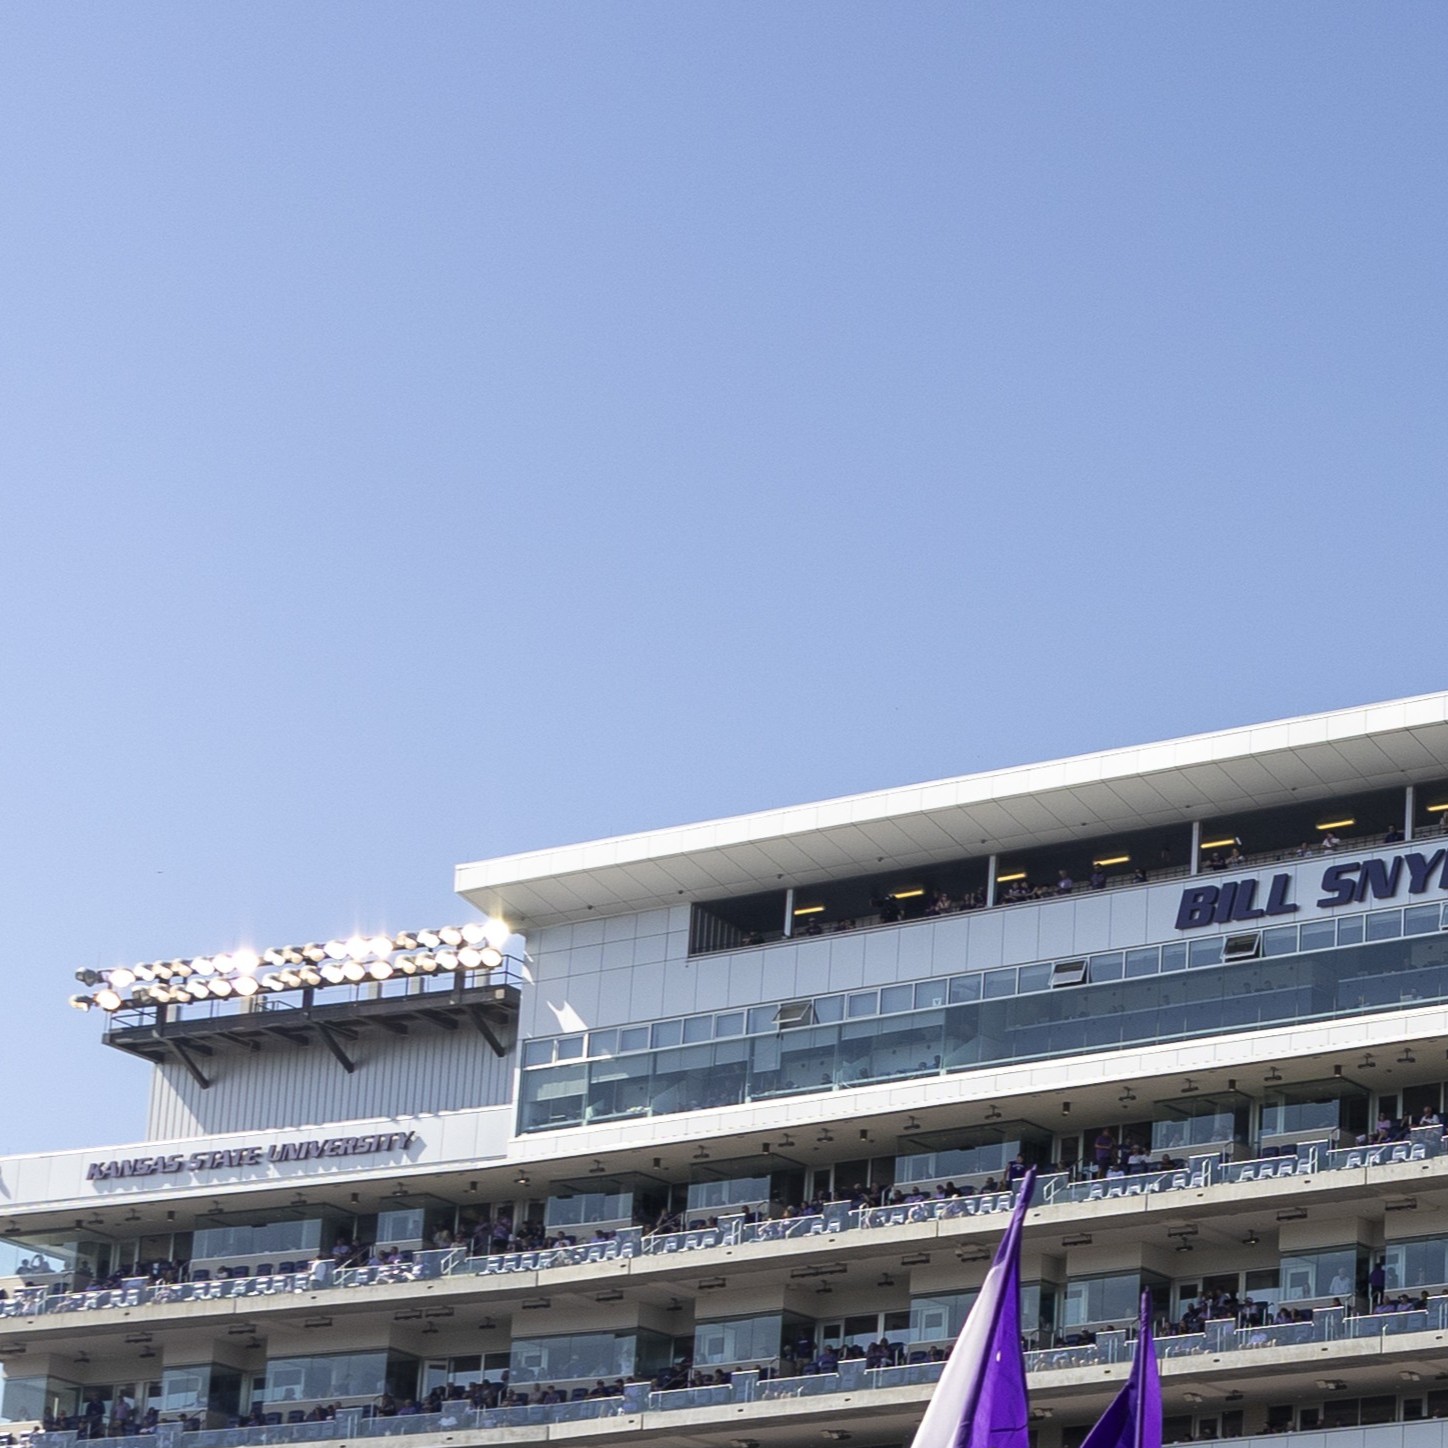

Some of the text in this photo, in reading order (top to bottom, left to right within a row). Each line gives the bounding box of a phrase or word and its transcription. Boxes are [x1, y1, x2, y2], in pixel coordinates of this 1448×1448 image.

[1175, 880, 1298, 930] BILL
[86, 1130, 416, 1181] KANSAS STATE UNIVERSITY
